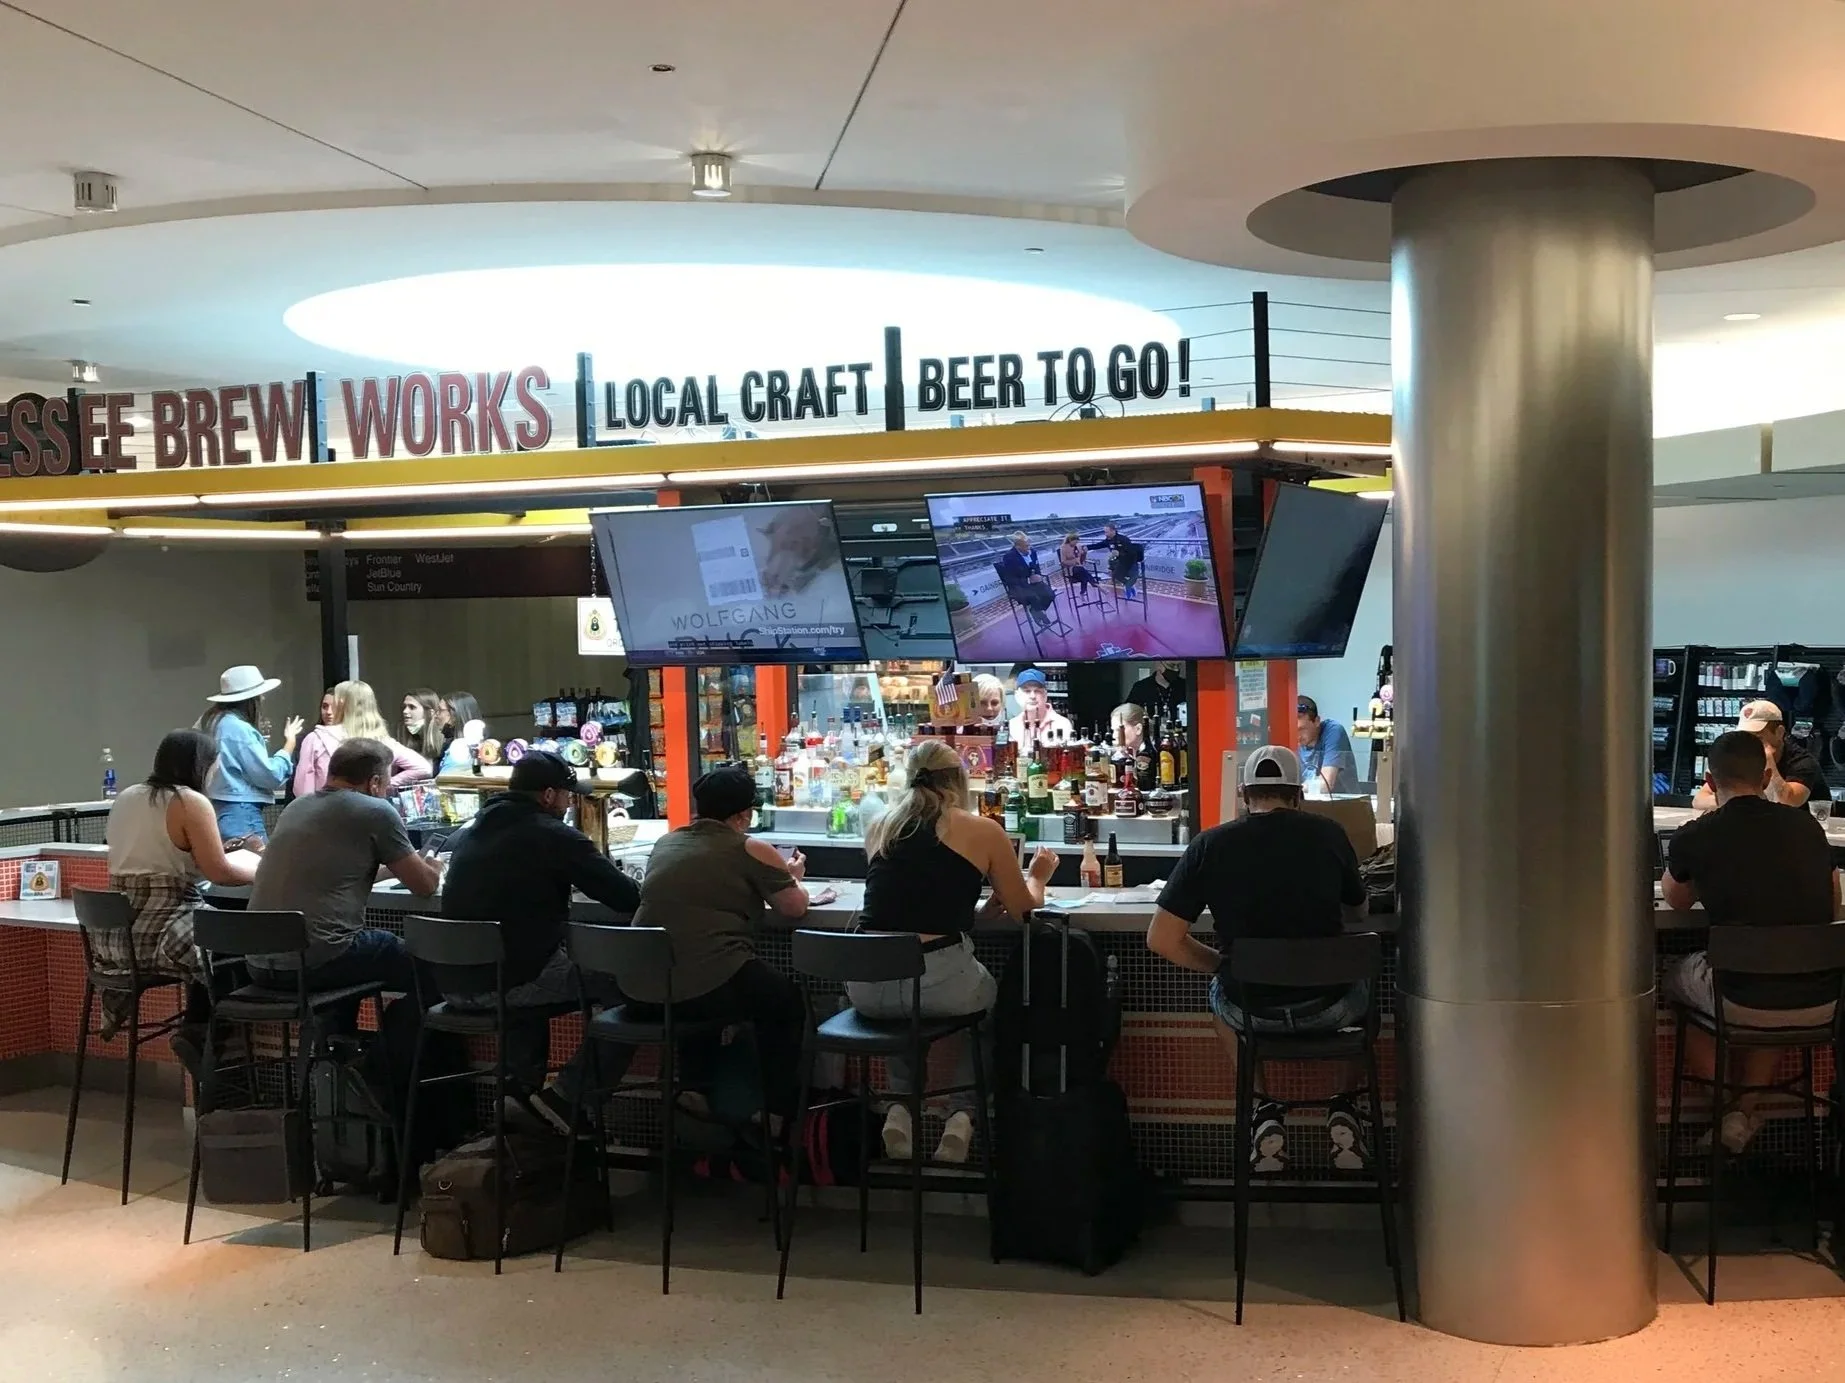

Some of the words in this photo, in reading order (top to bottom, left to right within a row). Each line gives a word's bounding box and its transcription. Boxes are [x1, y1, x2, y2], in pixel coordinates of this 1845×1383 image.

[605, 376, 729, 429] LOCAL
[740, 361, 872, 425] CRAFT
[918, 353, 1026, 412] BEER
[1037, 347, 1095, 405] TO
[153, 378, 307, 470] BREW
[340, 364, 551, 458] WORKS
[366, 554, 402, 566] Frontier
[415, 552, 455, 564] WestJet
[366, 567, 402, 579] JetBlue
[367, 581, 385, 593] Sun
[387, 581, 422, 594] Country
[671, 602, 797, 630] WOLFGANG
